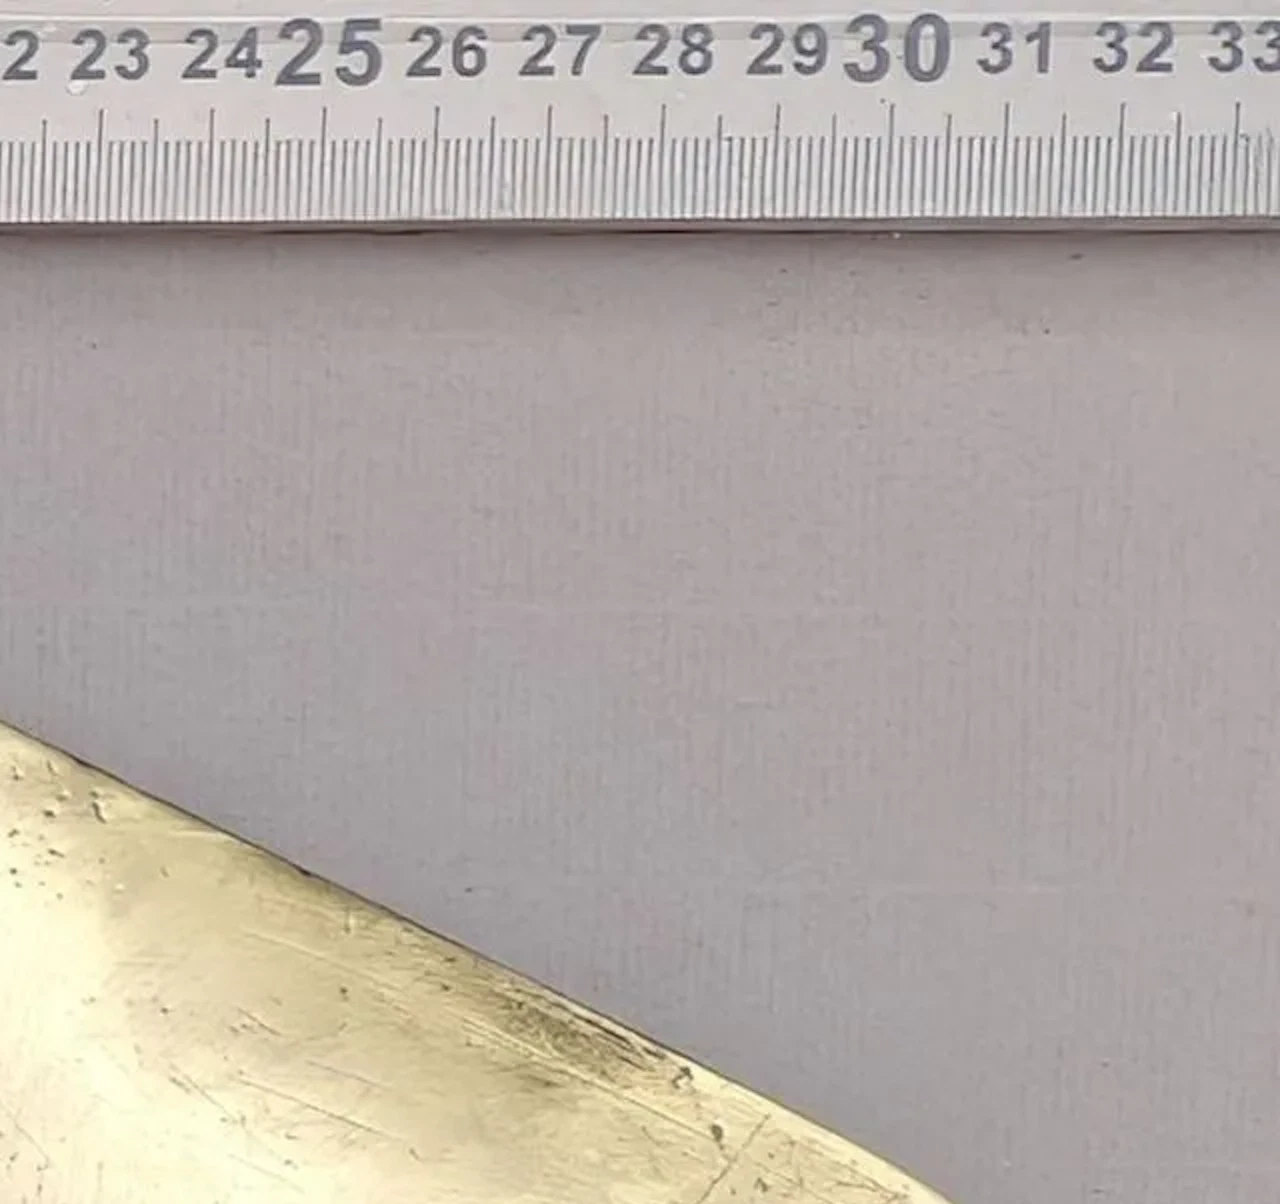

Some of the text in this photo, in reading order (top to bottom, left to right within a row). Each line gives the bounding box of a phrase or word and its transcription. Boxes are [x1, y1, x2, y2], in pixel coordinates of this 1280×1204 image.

[70, 27, 151, 81] 23
[179, 26, 263, 80] 24
[274, 18, 382, 87] 25
[405, 24, 489, 78] 26
[518, 23, 602, 77] 27
[632, 23, 714, 76] 28
[745, 22, 829, 76] 29
[842, 12, 951, 84] 30
[976, 21, 1052, 75] 31
[1092, 21, 1175, 74] 32
